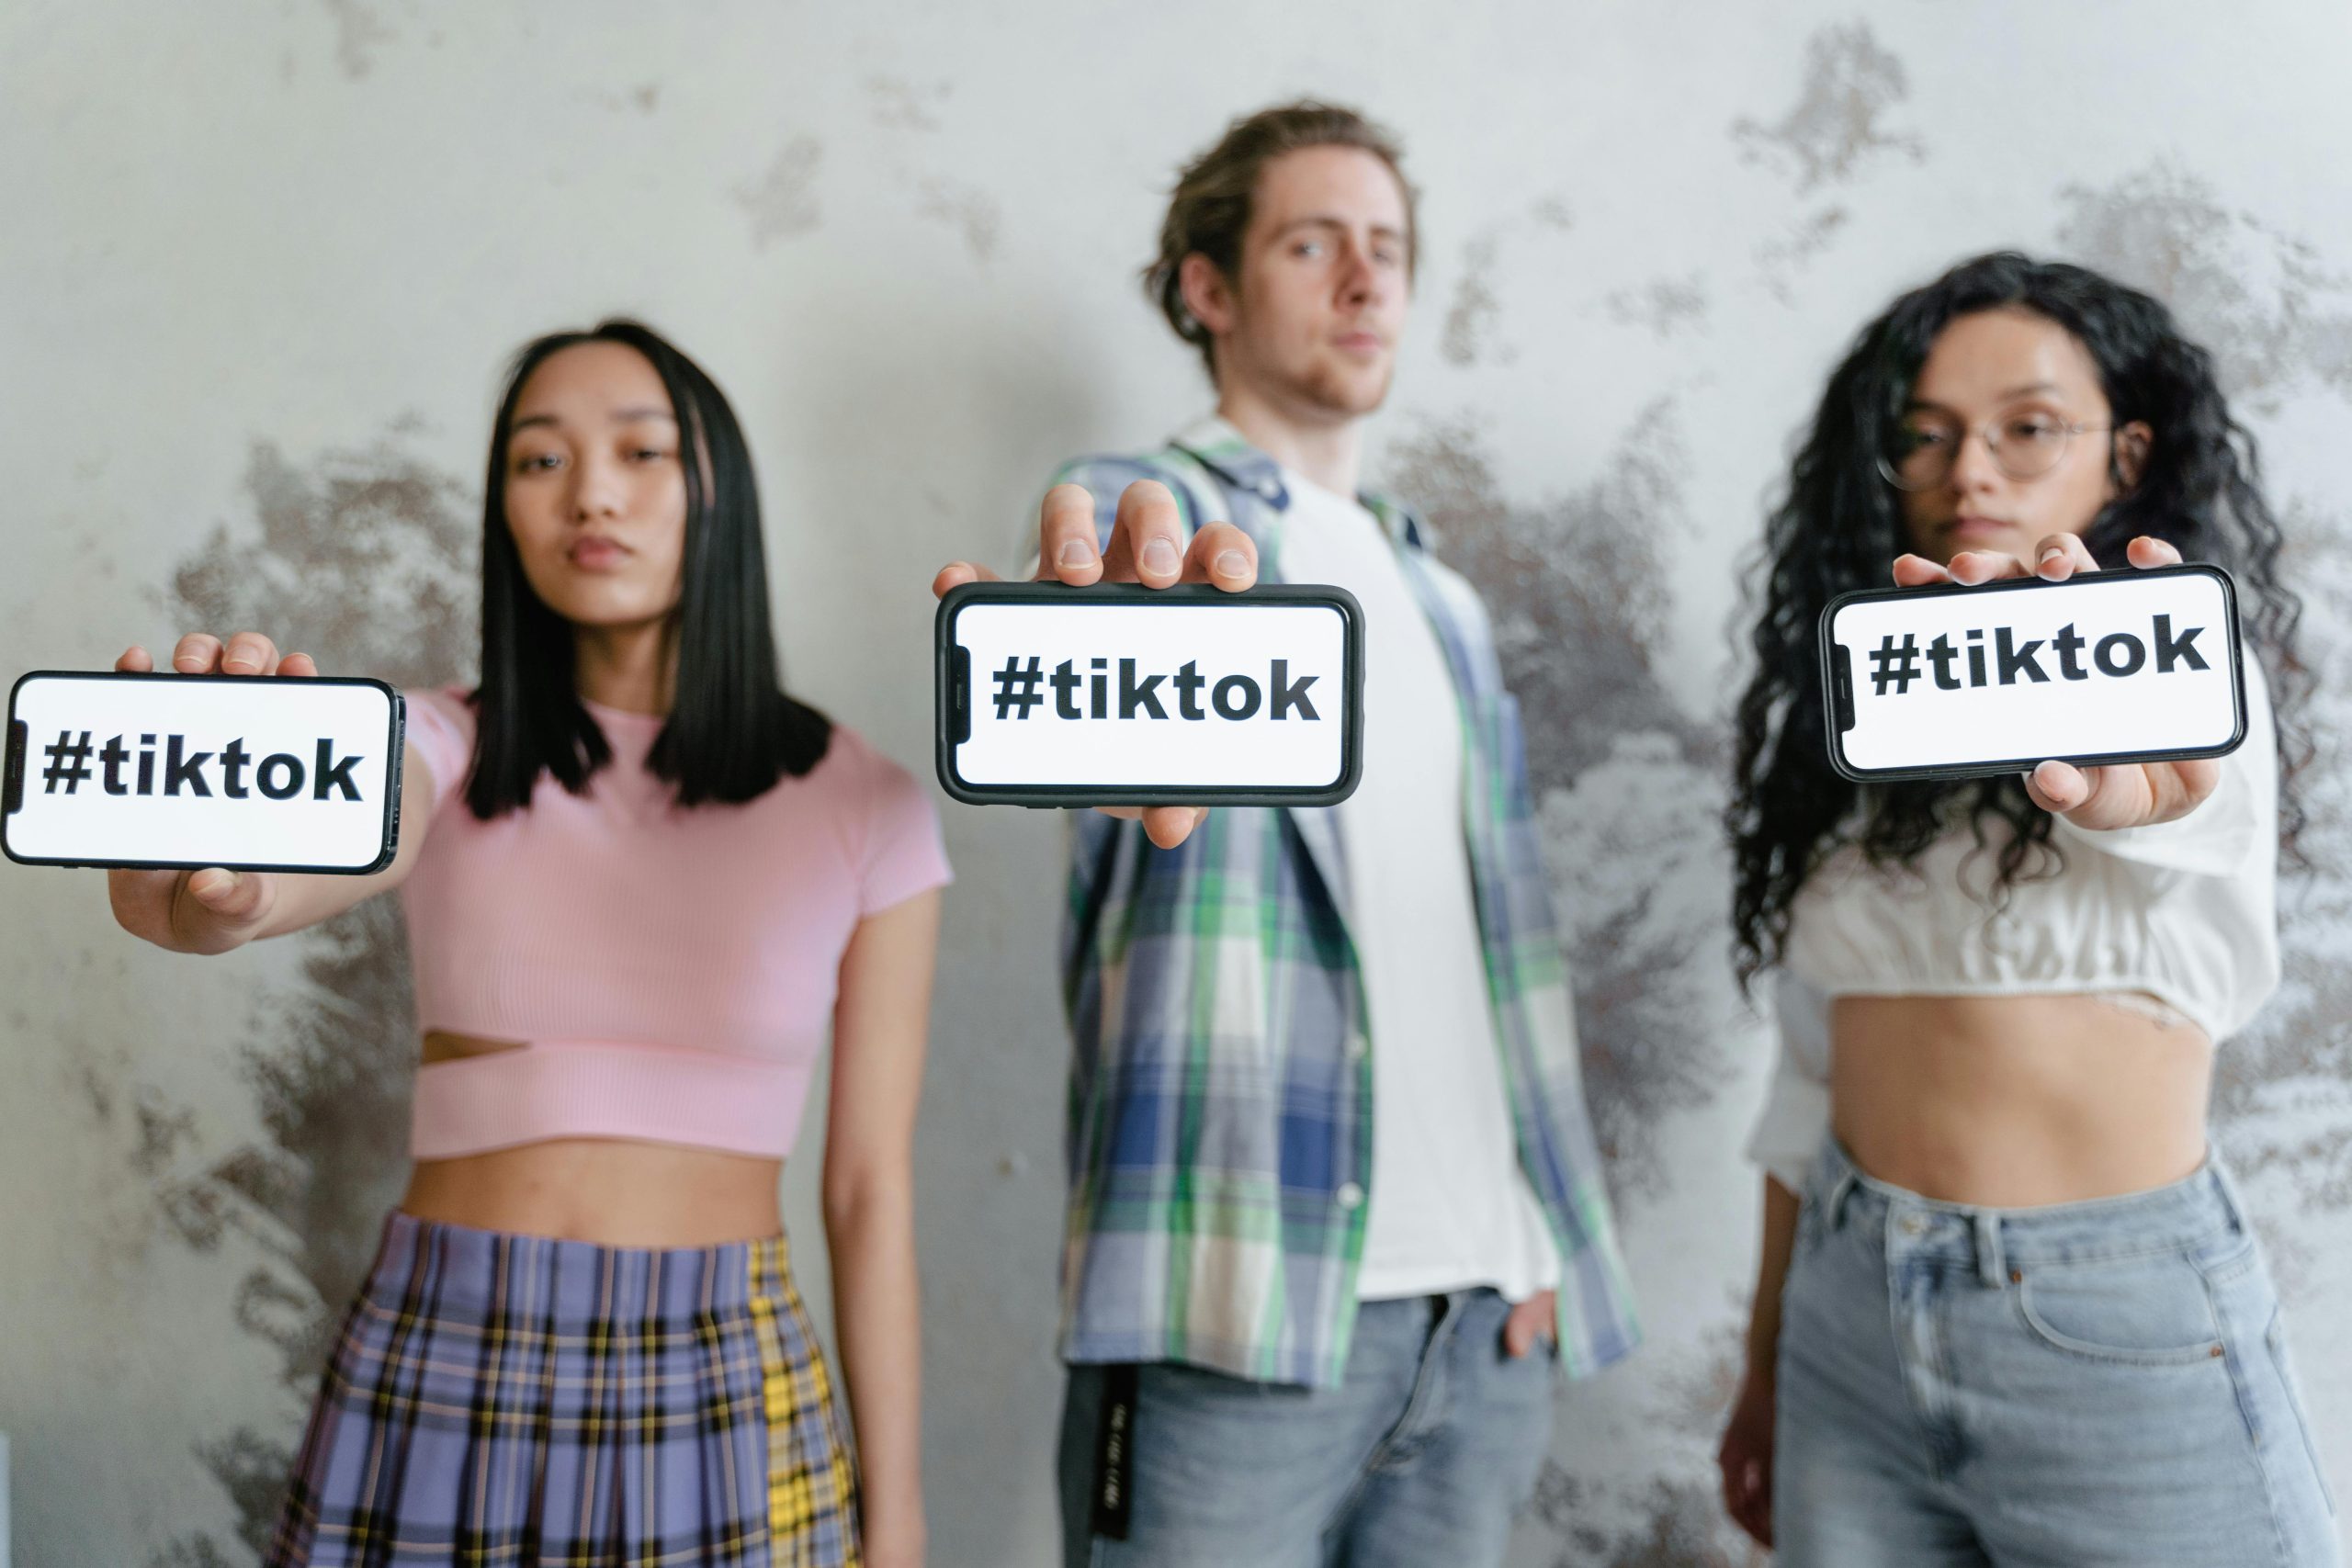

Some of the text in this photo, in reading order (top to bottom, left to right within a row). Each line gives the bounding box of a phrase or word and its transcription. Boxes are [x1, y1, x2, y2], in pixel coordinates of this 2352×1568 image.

[992, 656, 1321, 721] #tiktok
[1869, 614, 2211, 696] #tiktok
[42, 730, 364, 801] #tiktok
